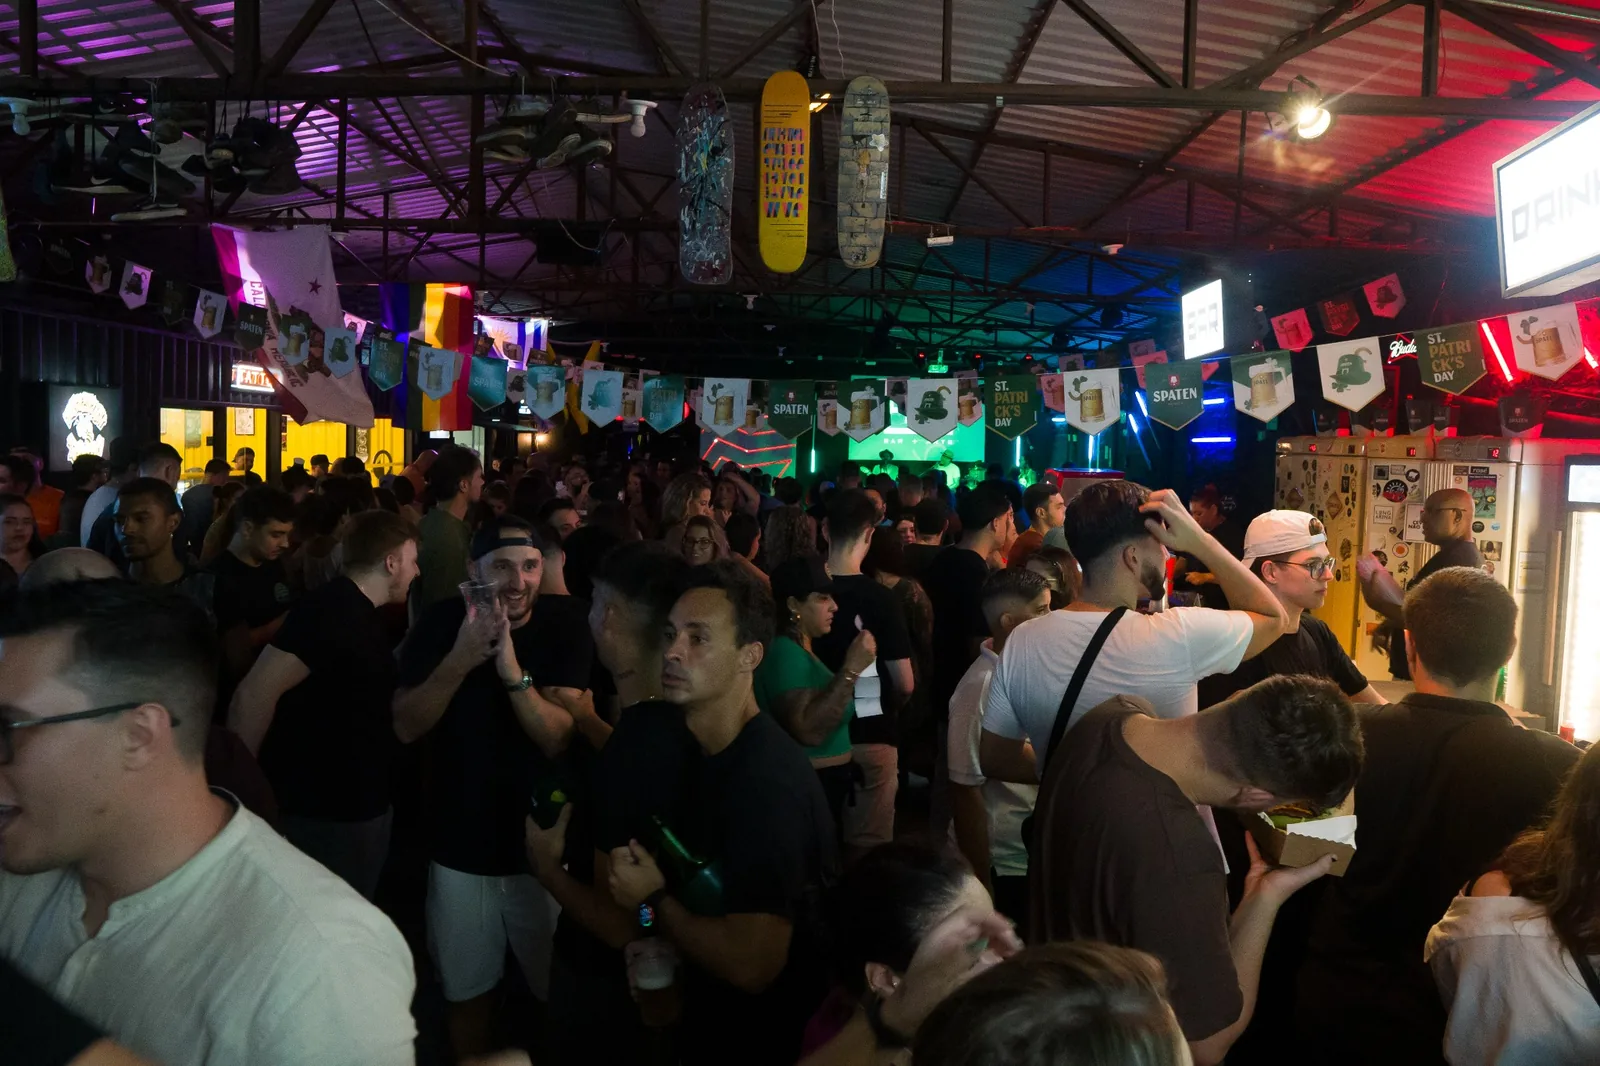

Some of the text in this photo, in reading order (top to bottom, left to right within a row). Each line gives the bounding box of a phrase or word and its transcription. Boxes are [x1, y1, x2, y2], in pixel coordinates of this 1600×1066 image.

[239, 321, 263, 336] SPATEN
[1427, 332, 1446, 345] ST.
[1429, 340, 1471, 358] PATRI
[1431, 356, 1465, 373] CK'S
[1433, 370, 1455, 383] DAY
[995, 381, 1009, 392] ST.
[995, 391, 1028, 404] PATRI
[1153, 388, 1197, 403] SPATEN
[773, 404, 809, 415] SPATEN
[995, 403, 1021, 417] CK'S
[995, 417, 1011, 428] DAY
